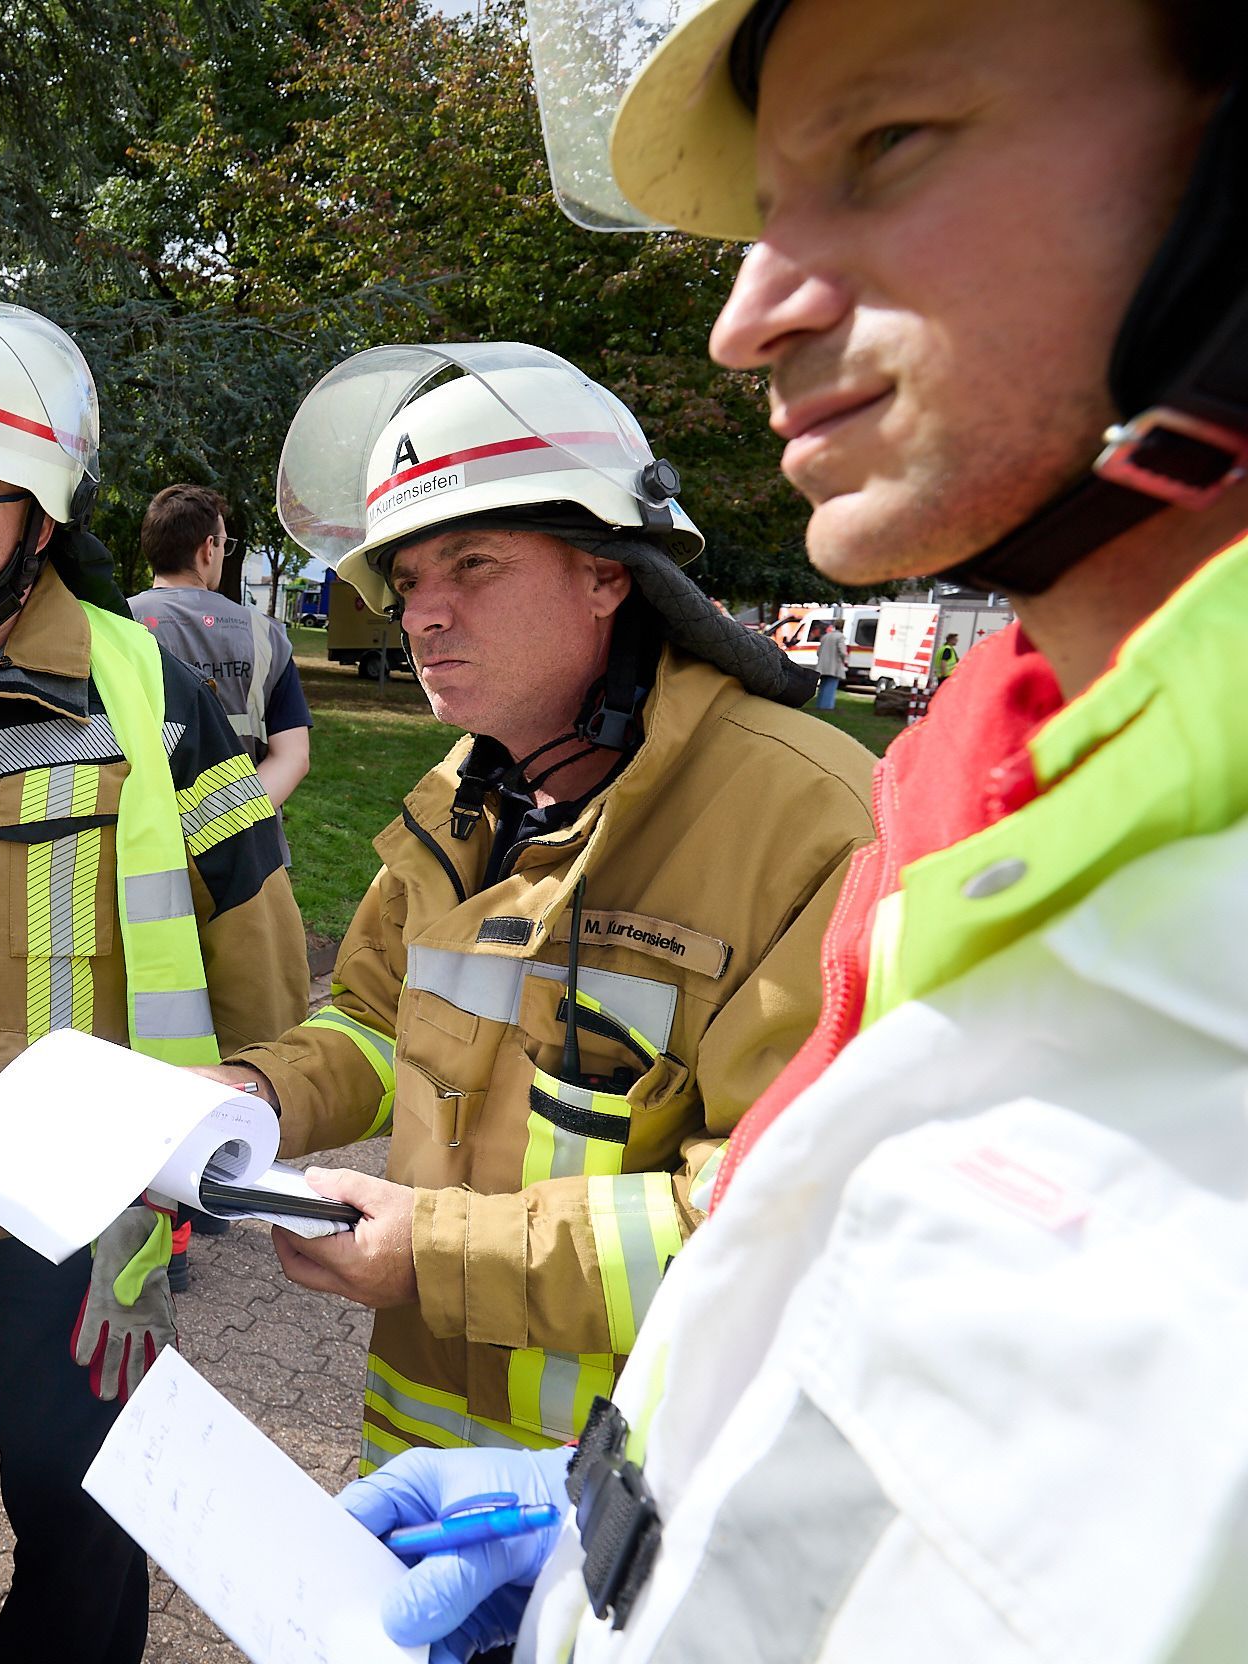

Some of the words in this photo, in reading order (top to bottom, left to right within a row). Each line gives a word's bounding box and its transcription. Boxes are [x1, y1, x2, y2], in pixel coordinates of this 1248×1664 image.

[391, 432, 419, 475] A
[584, 918, 602, 935] M.
[606, 919, 686, 956] Kurtensiefen
